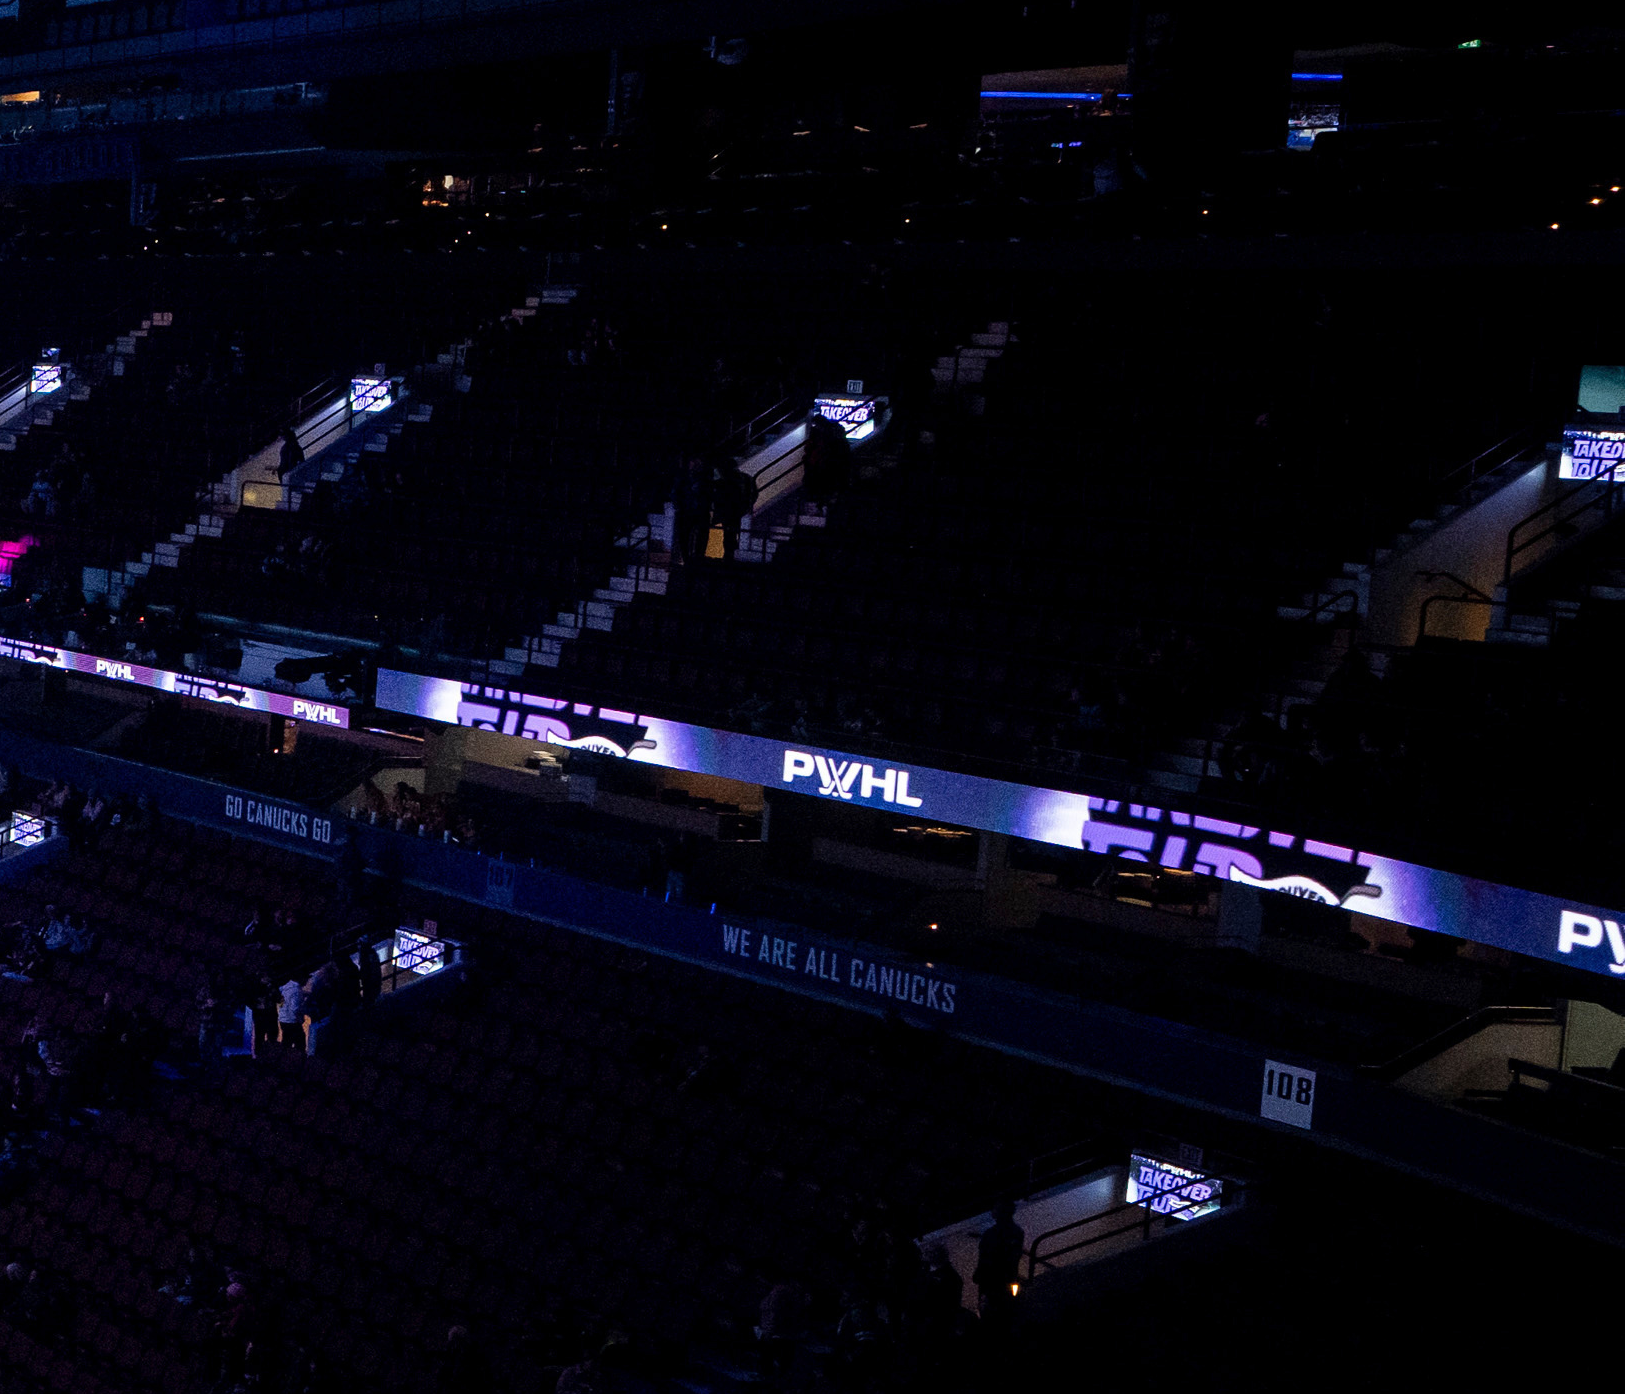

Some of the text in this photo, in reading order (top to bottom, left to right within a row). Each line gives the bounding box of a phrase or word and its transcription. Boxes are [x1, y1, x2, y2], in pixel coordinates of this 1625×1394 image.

[96, 659, 135, 681] PWHL
[292, 700, 342, 725] PWHL
[784, 749, 923, 809] PWHL
[225, 793, 331, 844] GO CANUCKS GO
[722, 923, 956, 1014] WE ARE ALL CANUCKS
[1266, 1068, 1313, 1106] 108
